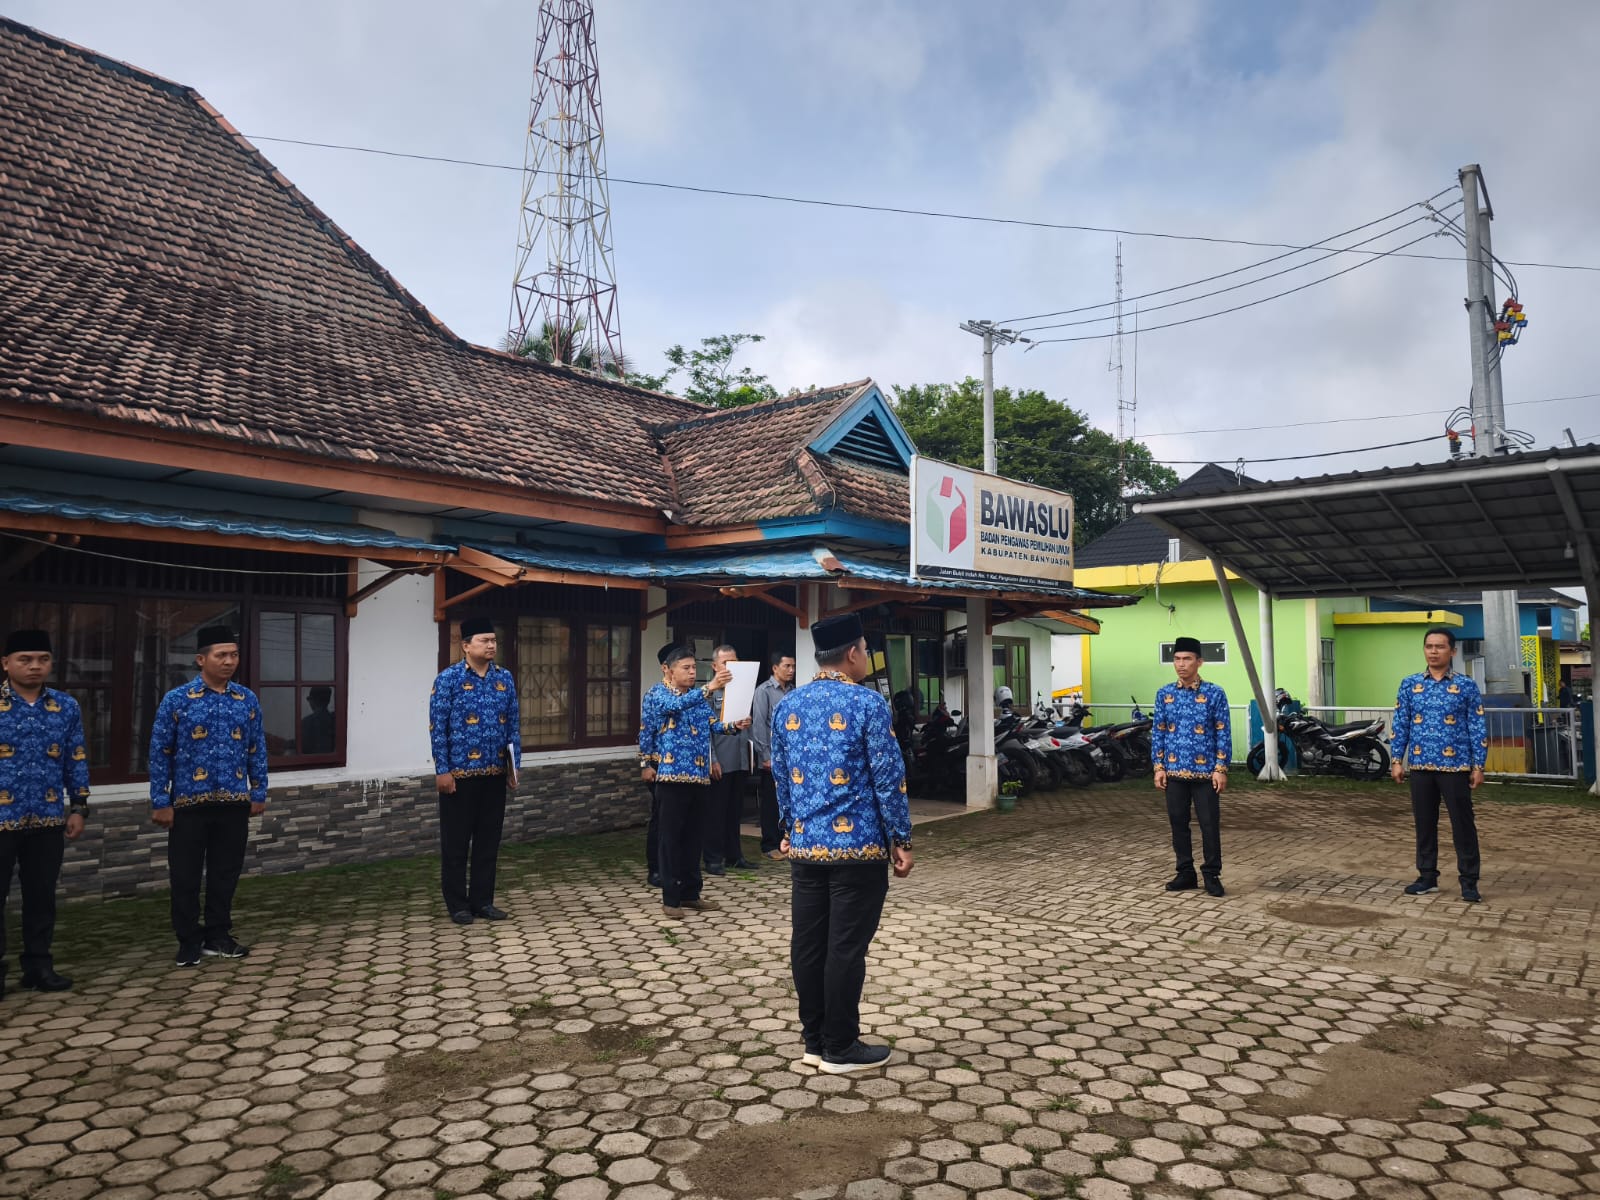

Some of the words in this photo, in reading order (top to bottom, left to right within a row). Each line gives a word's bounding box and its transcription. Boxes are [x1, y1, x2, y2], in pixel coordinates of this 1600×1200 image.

[981, 489, 1069, 540] BAWASLU
[980, 531, 1000, 544] BADAN
[1000, 535, 1029, 549] PENGAWAS
[1030, 540, 1056, 553] PEMILIHAN
[981, 547, 1028, 560] KABUPATEN
[1030, 554, 1070, 566] BANYUASIN
